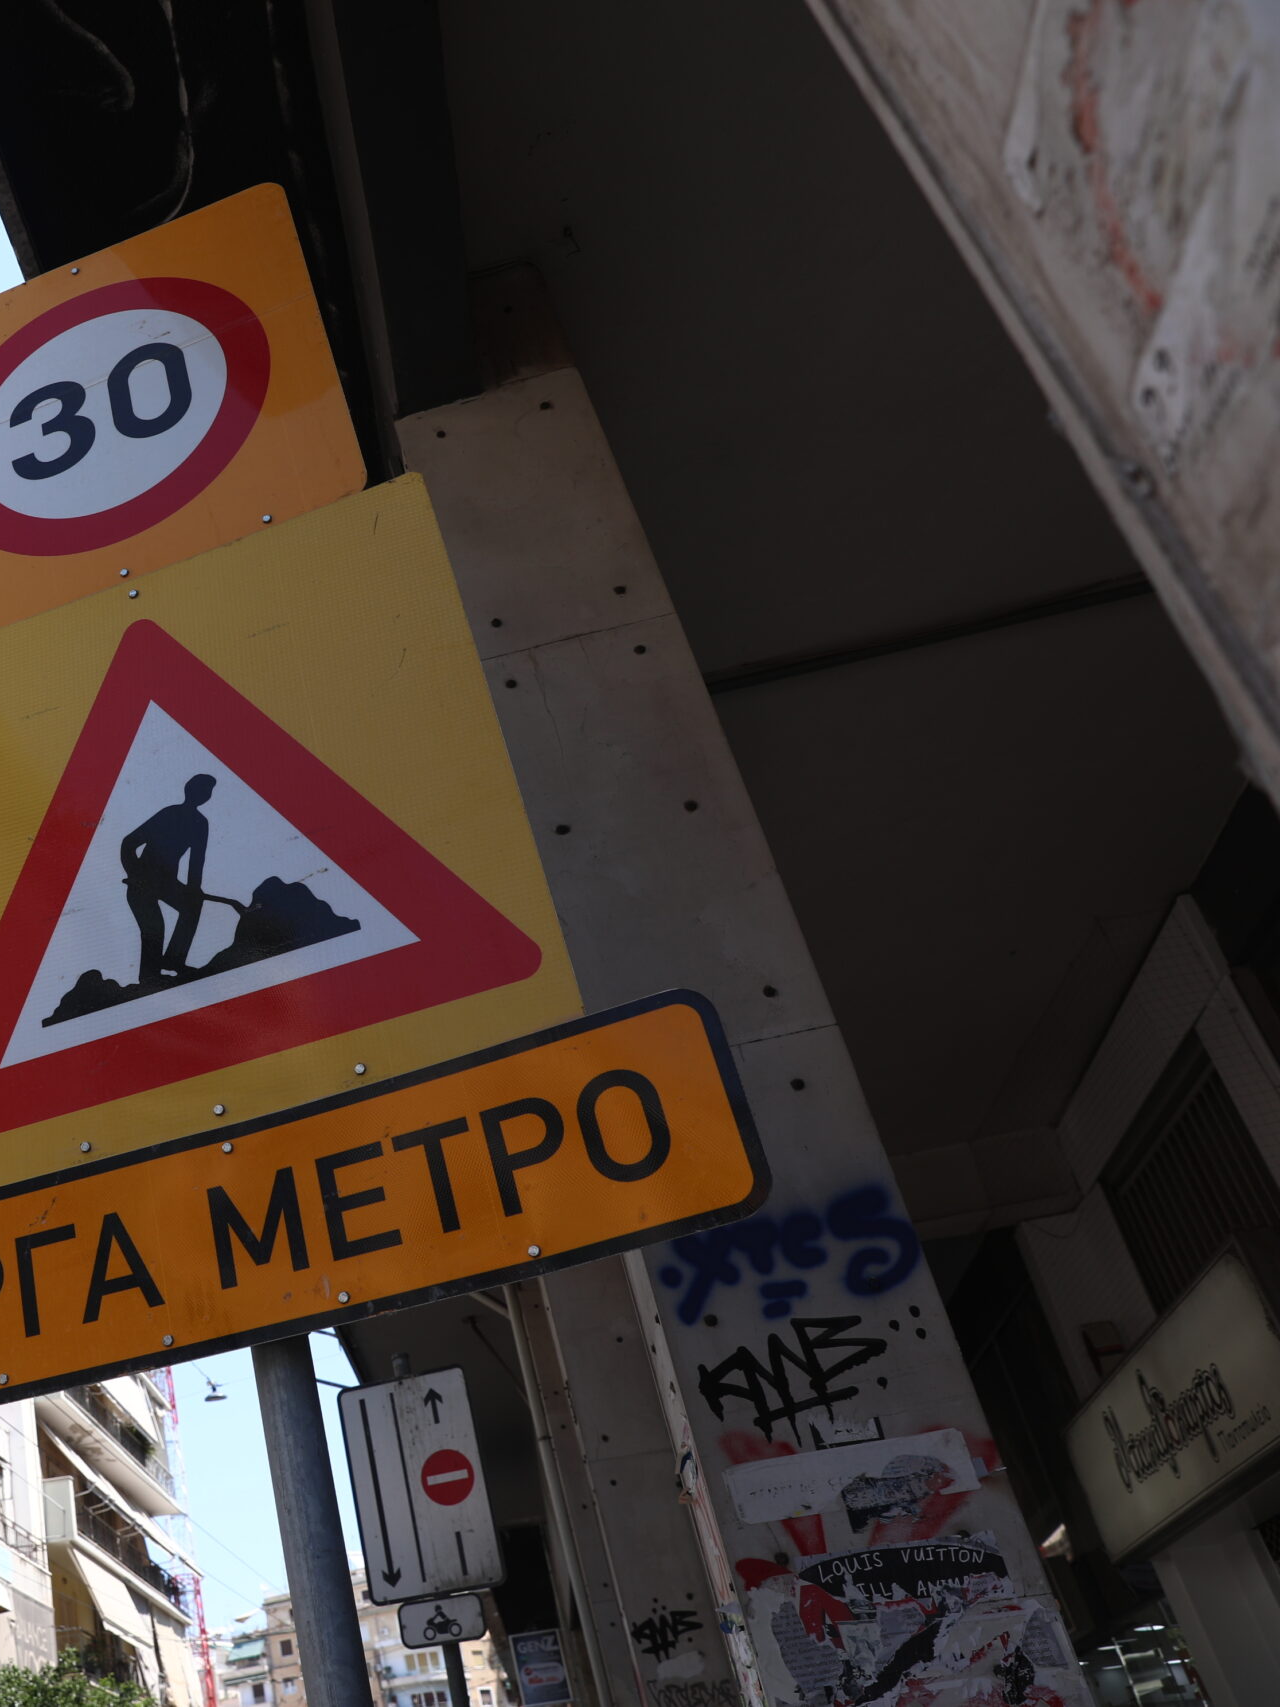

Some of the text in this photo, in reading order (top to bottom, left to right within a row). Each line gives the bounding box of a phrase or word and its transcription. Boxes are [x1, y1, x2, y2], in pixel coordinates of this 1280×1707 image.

[9, 342, 192, 480] 30
[206, 1068, 671, 1289] ΜΕΤΡΟ
[817, 1546, 985, 1584] LOUIS VUITTON
